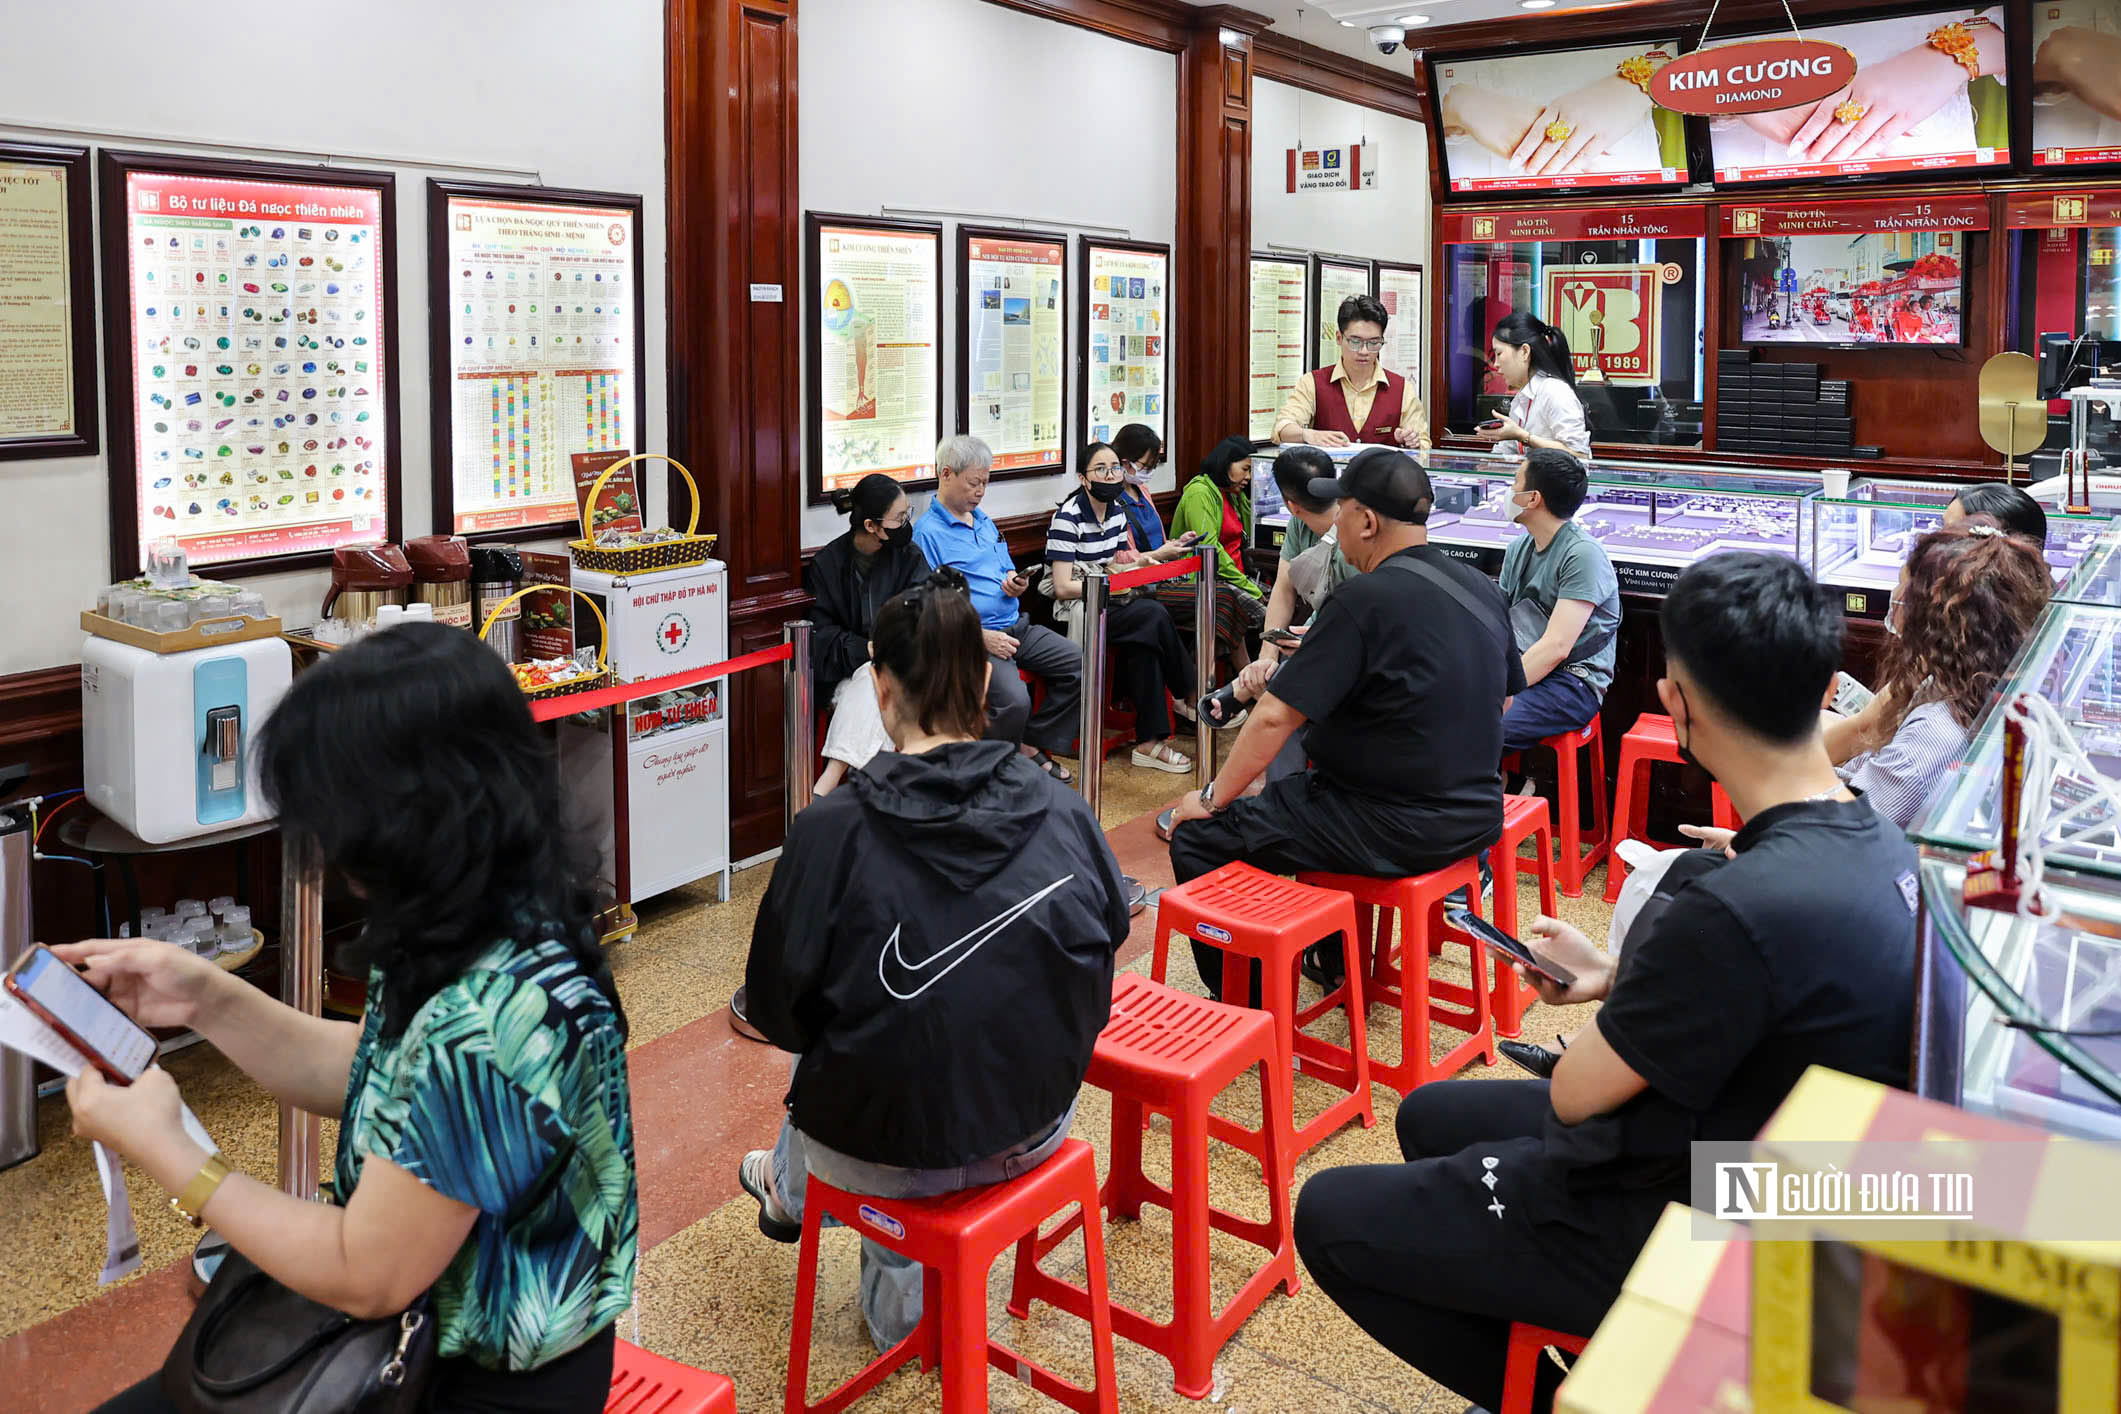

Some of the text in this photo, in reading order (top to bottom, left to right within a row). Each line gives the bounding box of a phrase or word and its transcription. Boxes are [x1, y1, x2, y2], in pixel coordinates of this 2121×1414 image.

[1669, 55, 1833, 92] KIM CƯƠNG
[1715, 88, 1782, 104] DIAMOND
[1300, 181, 1317, 189] VÀNG
[1365, 178, 1371, 186] 4
[169, 195, 364, 219] Bộ tư liệu Đá ngọc thiên nhiên
[1915, 205, 1931, 215] 15
[1621, 215, 1634, 224] 15
[1787, 209, 1826, 219] BẢO TÍN
[1517, 217, 1549, 227] BẢO TÍN
[1778, 217, 1834, 229] MINH CHÂU
[1874, 215, 1974, 228] TRẦN NHÂN TÔNG
[497, 228, 518, 236] THEO
[544, 231, 560, 239] SINH
[1509, 226, 1556, 236] MINH CHÂU
[1588, 223, 1669, 236] TRẦN NHÂN TÔNG
[1605, 356, 1641, 369] 1989
[1450, 550, 1464, 558] CAO
[1465, 550, 1479, 559] CẤP
[1619, 566, 1679, 580] SỨC KIM CƯƠNG
[633, 582, 718, 608] HỘI CHỮ THẬP ĐỎ TP HÀ NỘI
